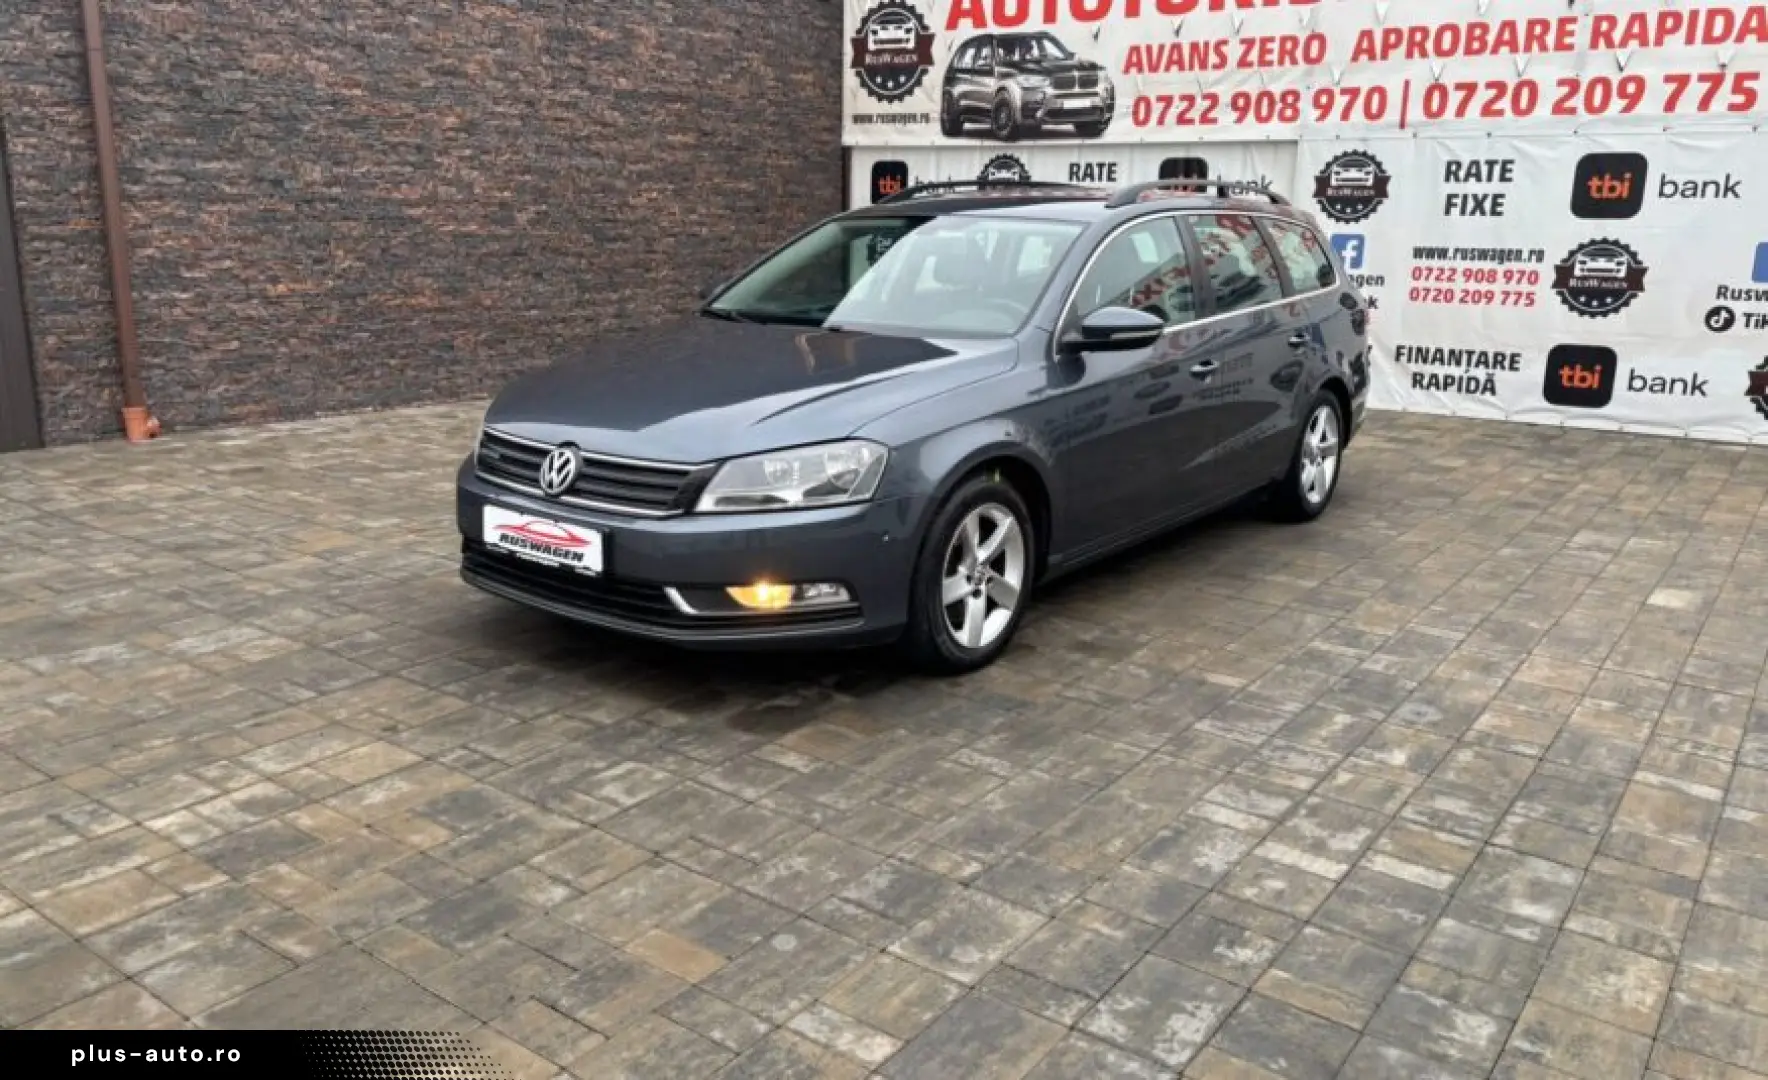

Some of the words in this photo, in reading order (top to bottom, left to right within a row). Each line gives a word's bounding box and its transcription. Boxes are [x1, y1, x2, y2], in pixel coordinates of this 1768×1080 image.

[1123, 40, 1229, 75] AVANS
[1237, 32, 1327, 69] ZERO
[1351, 16, 1578, 62] APROBARE
[1589, 6, 1768, 49] RAPIDA
[1131, 93, 1220, 127] 0722
[1230, 89, 1301, 124] 908
[1312, 85, 1387, 122] 970
[1422, 79, 1539, 119] 0720
[1551, 75, 1646, 116] 209
[1663, 72, 1760, 113] 775
[1068, 162, 1118, 183] RATE
[1444, 159, 1515, 183] RATE
[1587, 172, 1633, 200] tbi
[1658, 172, 1742, 200] bank
[1443, 193, 1506, 217] FIXE
[1412, 246, 1545, 264] www.ruswagen.ro
[1412, 266, 1457, 282] 0722
[1462, 268, 1498, 283] 908
[1503, 270, 1540, 285] 970
[1409, 287, 1455, 303] 0720
[1459, 289, 1495, 305] 209
[1500, 290, 1536, 307] 775
[1411, 371, 1497, 396] RAPIDĂ
[1559, 363, 1602, 389] tbi
[1627, 367, 1709, 397] bank
[499, 532, 585, 562] RUSWAGEN
